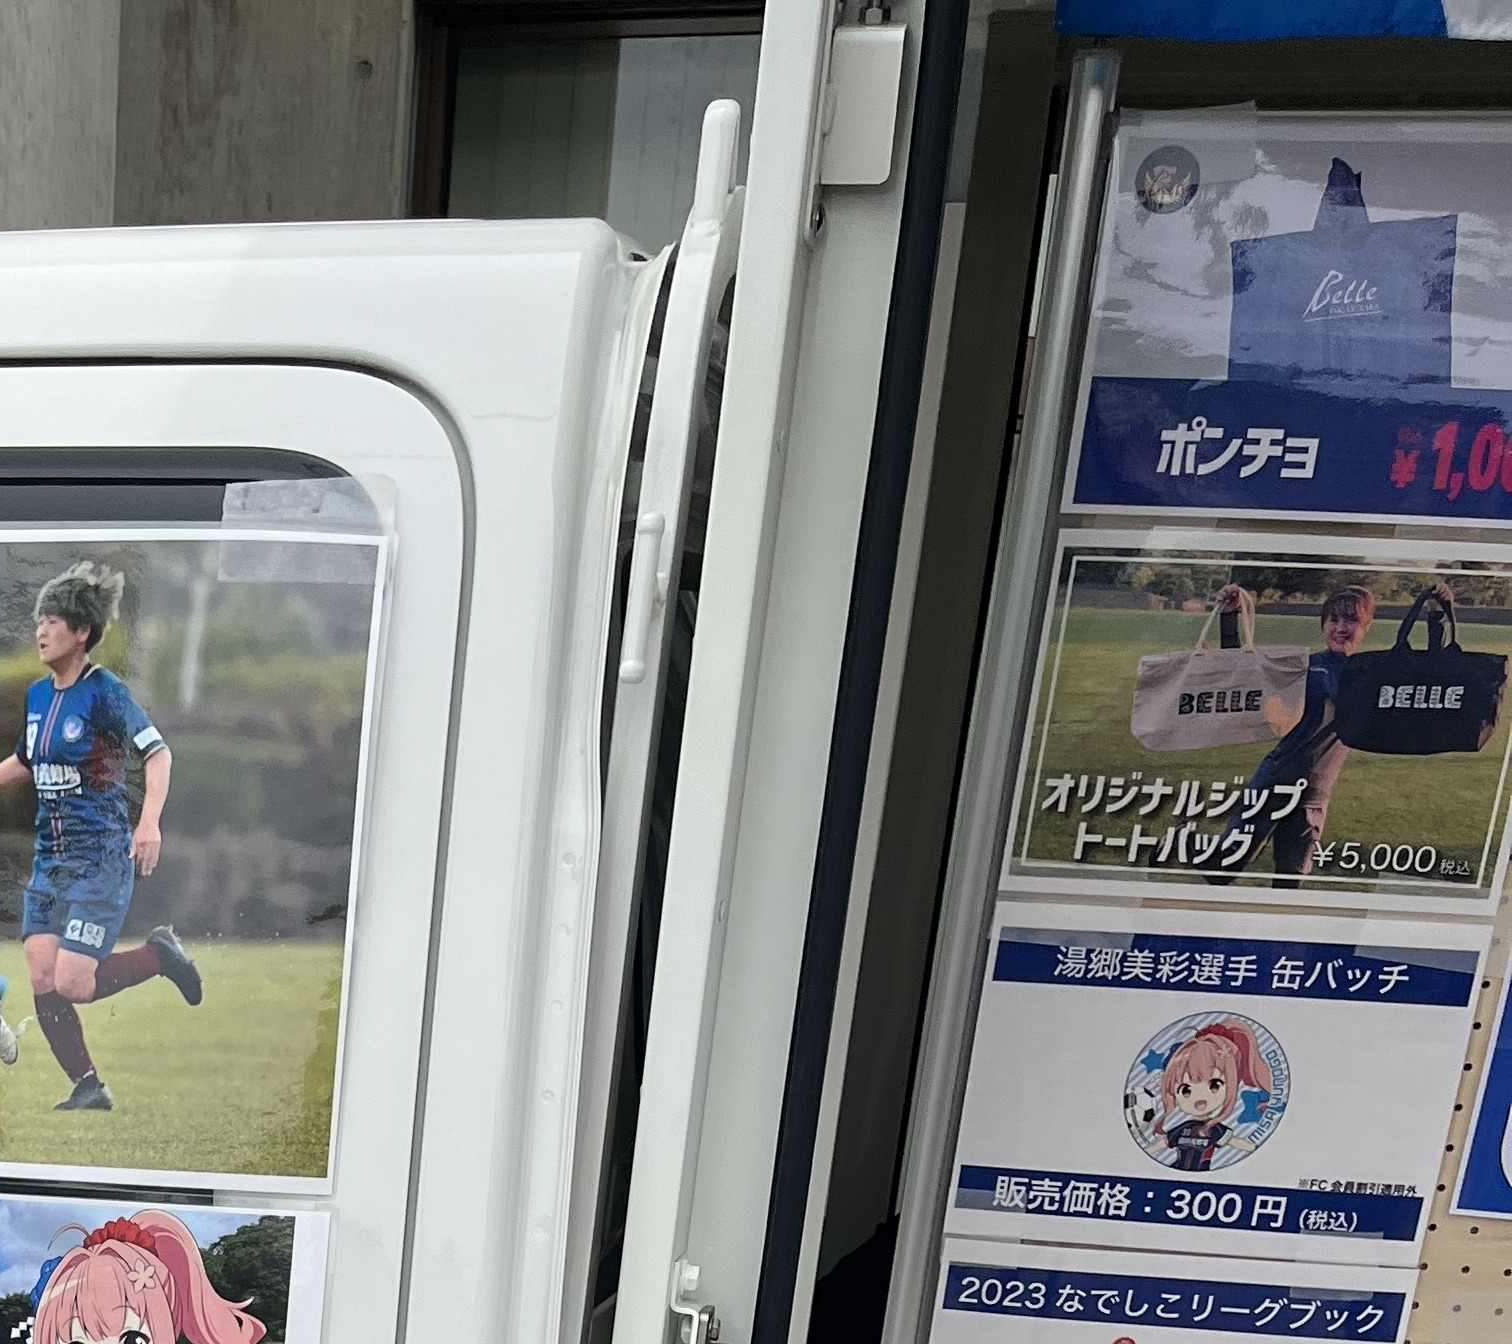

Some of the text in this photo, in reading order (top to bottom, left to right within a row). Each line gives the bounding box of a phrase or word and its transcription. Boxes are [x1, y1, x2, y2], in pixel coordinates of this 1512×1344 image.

[1156, 415, 1320, 479] ポンチョ
[1177, 690, 1263, 715] BELLE
[1378, 685, 1465, 709] BELLE
[1042, 772, 1308, 821] オリジナルジップ
[1073, 822, 1256, 867] トートバッグ
[1053, 945, 1410, 995] 湯郷美彩選手 缶バッチ
[959, 1277, 1386, 1335] 2023 なでしこリーグブック
